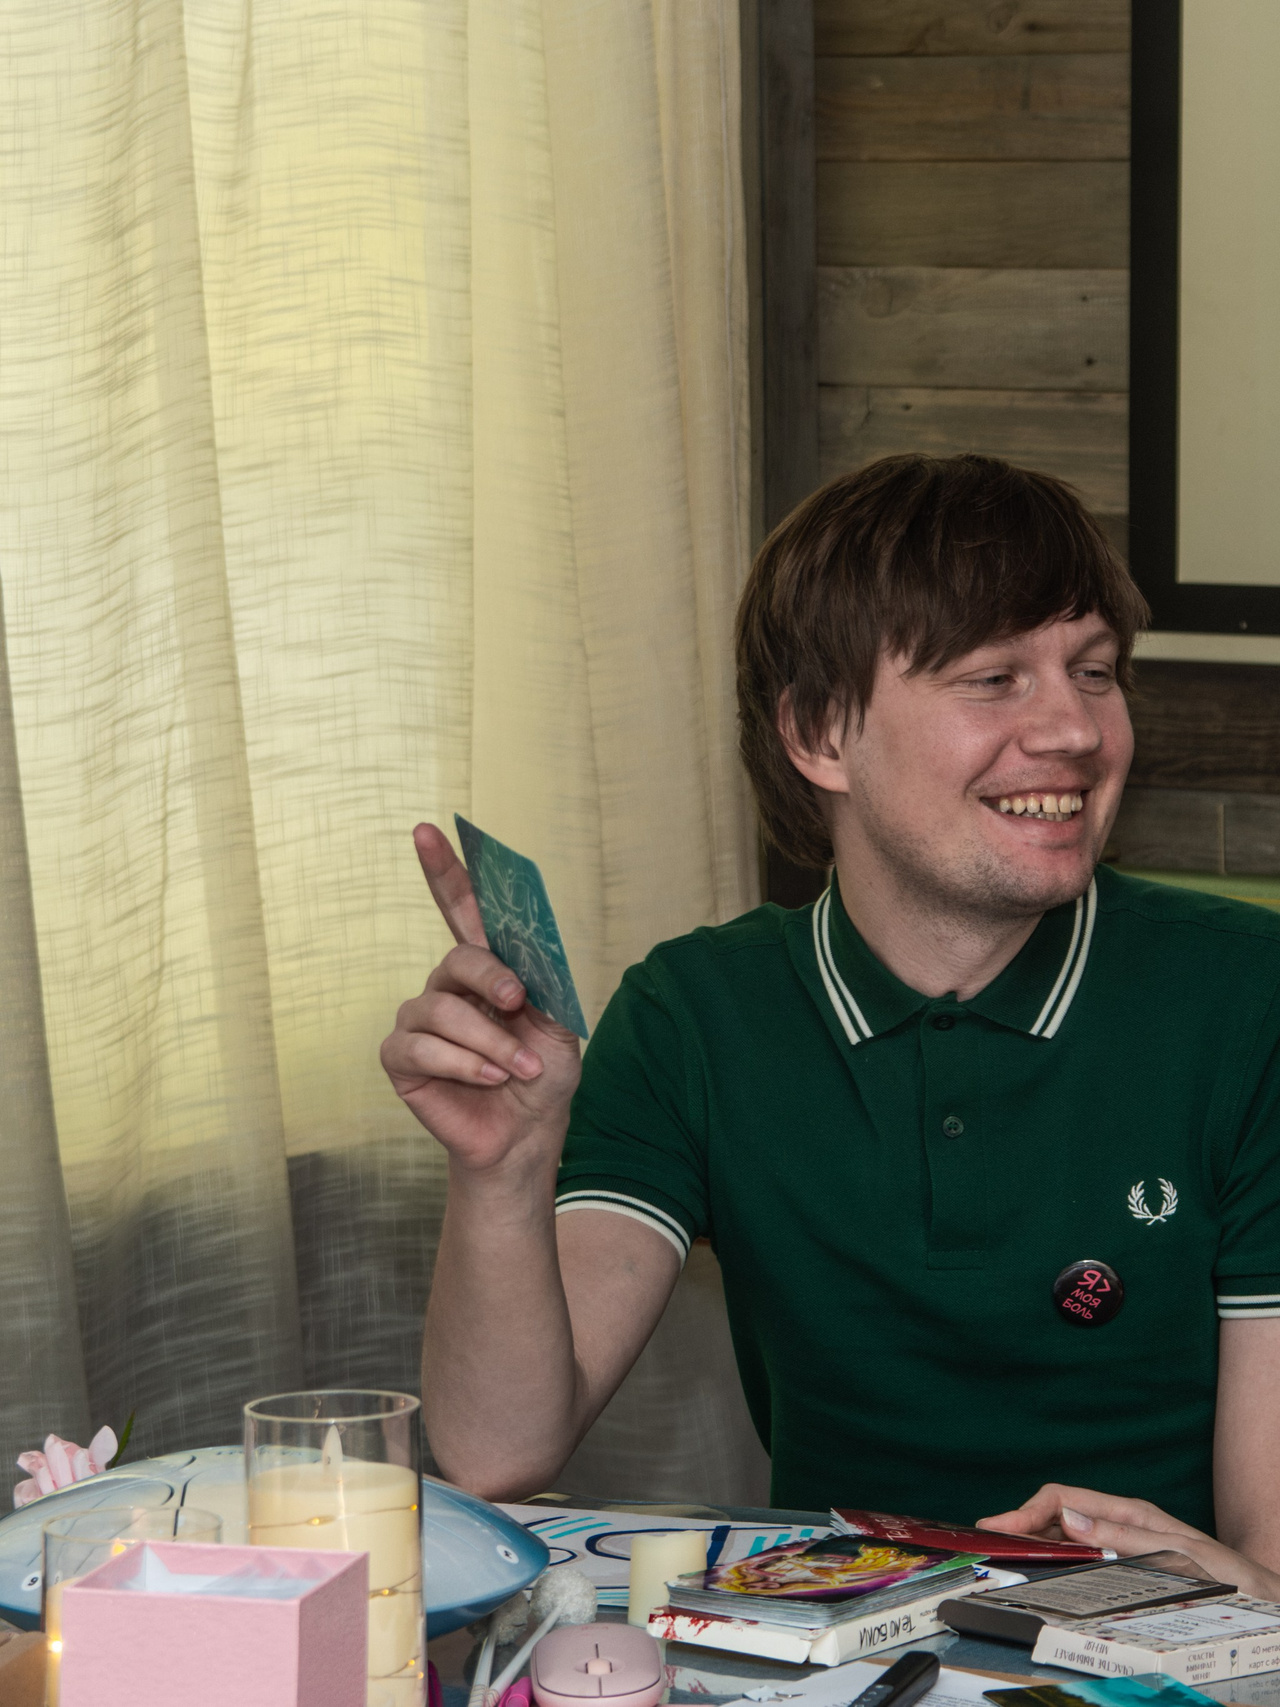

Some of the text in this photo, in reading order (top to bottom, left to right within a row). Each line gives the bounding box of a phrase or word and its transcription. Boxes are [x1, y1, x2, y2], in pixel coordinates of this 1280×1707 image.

[1070, 1287, 1102, 1309] МОЯ
[1062, 1297, 1094, 1320] БОЛЬ
[1084, 1639, 1110, 1655] МЕНЯ!
[1251, 1645, 1262, 1656] 40
[1053, 1647, 1094, 1667] ВЫБИРАЕТ
[1248, 1657, 1265, 1671] карт
